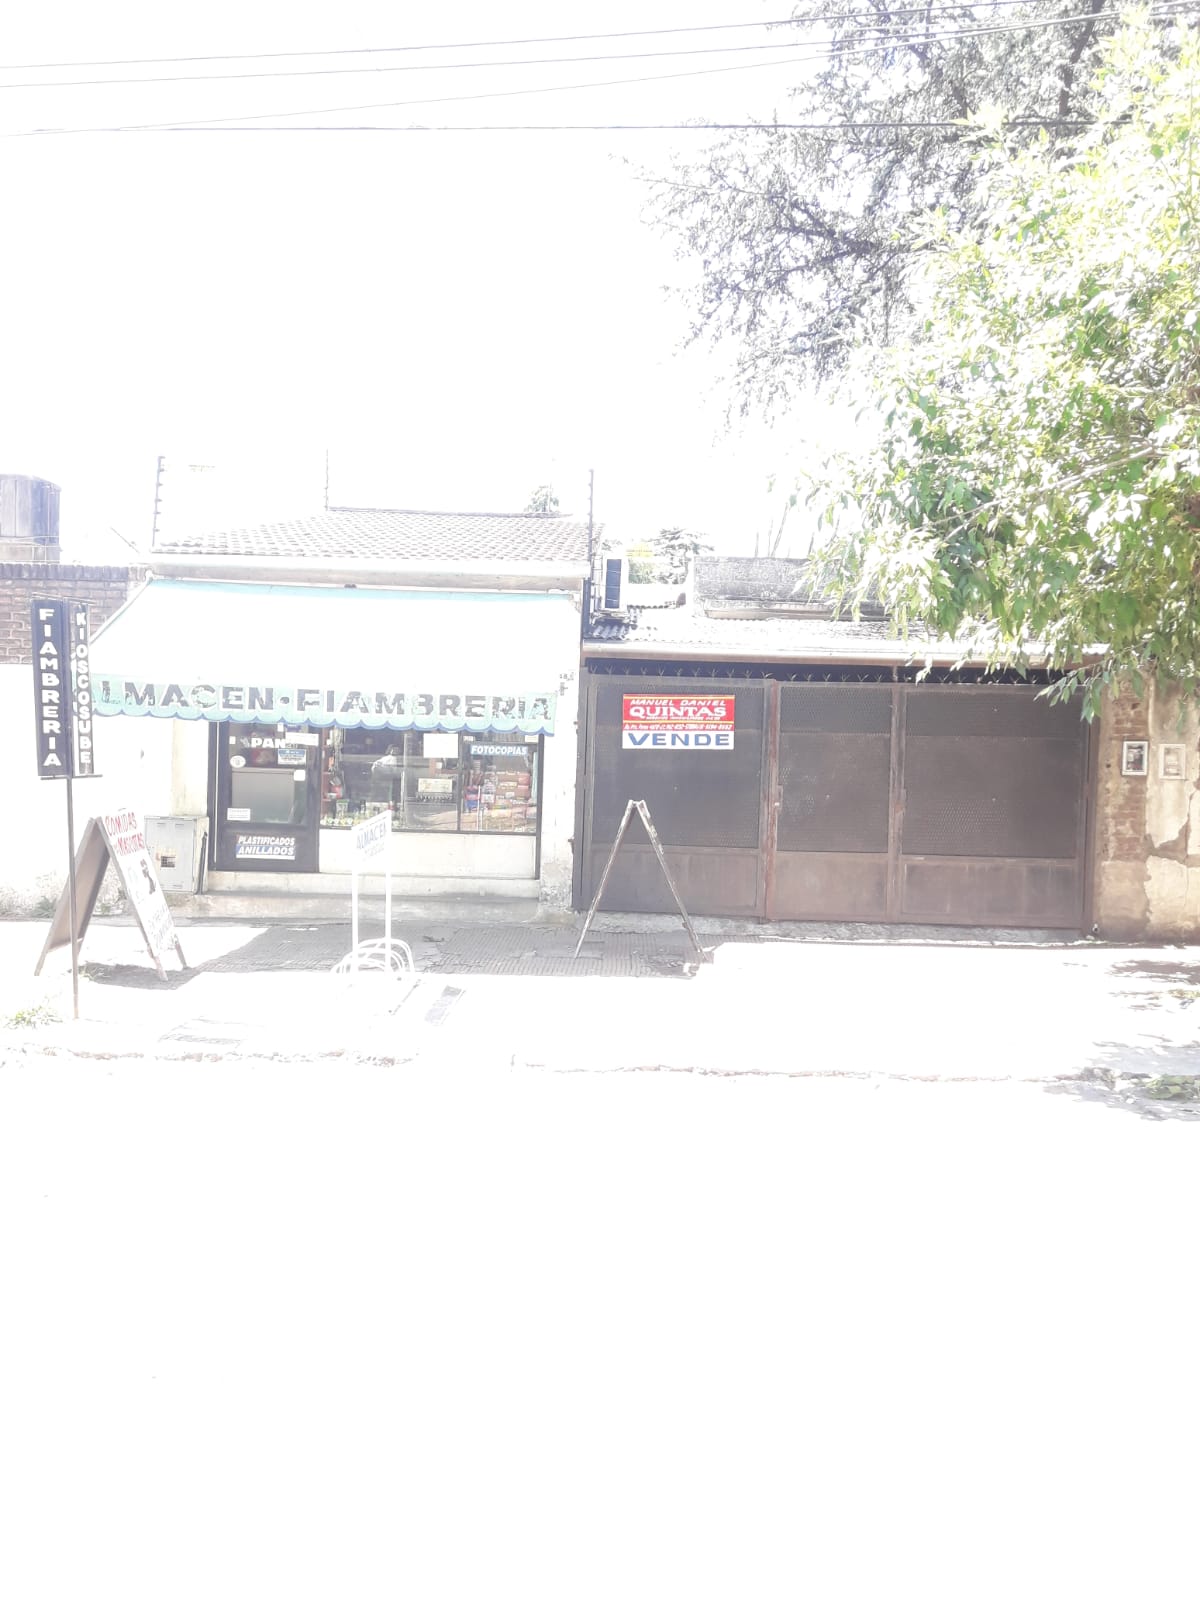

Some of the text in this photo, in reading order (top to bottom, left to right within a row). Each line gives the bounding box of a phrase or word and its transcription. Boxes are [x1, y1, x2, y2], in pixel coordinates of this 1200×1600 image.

[38, 608, 62, 767] FIAMBRERIA
[92, 679, 553, 721] LMACEN FIAMBRERIA
[629, 706, 727, 718] QUINTAS
[251, 737, 286, 748] PAN
[627, 732, 730, 746] VENDE
[470, 745, 528, 756] FOTOCOPIAS
[237, 836, 296, 846] PLASTIFICADOS
[237, 846, 295, 856] ANILLADOS
